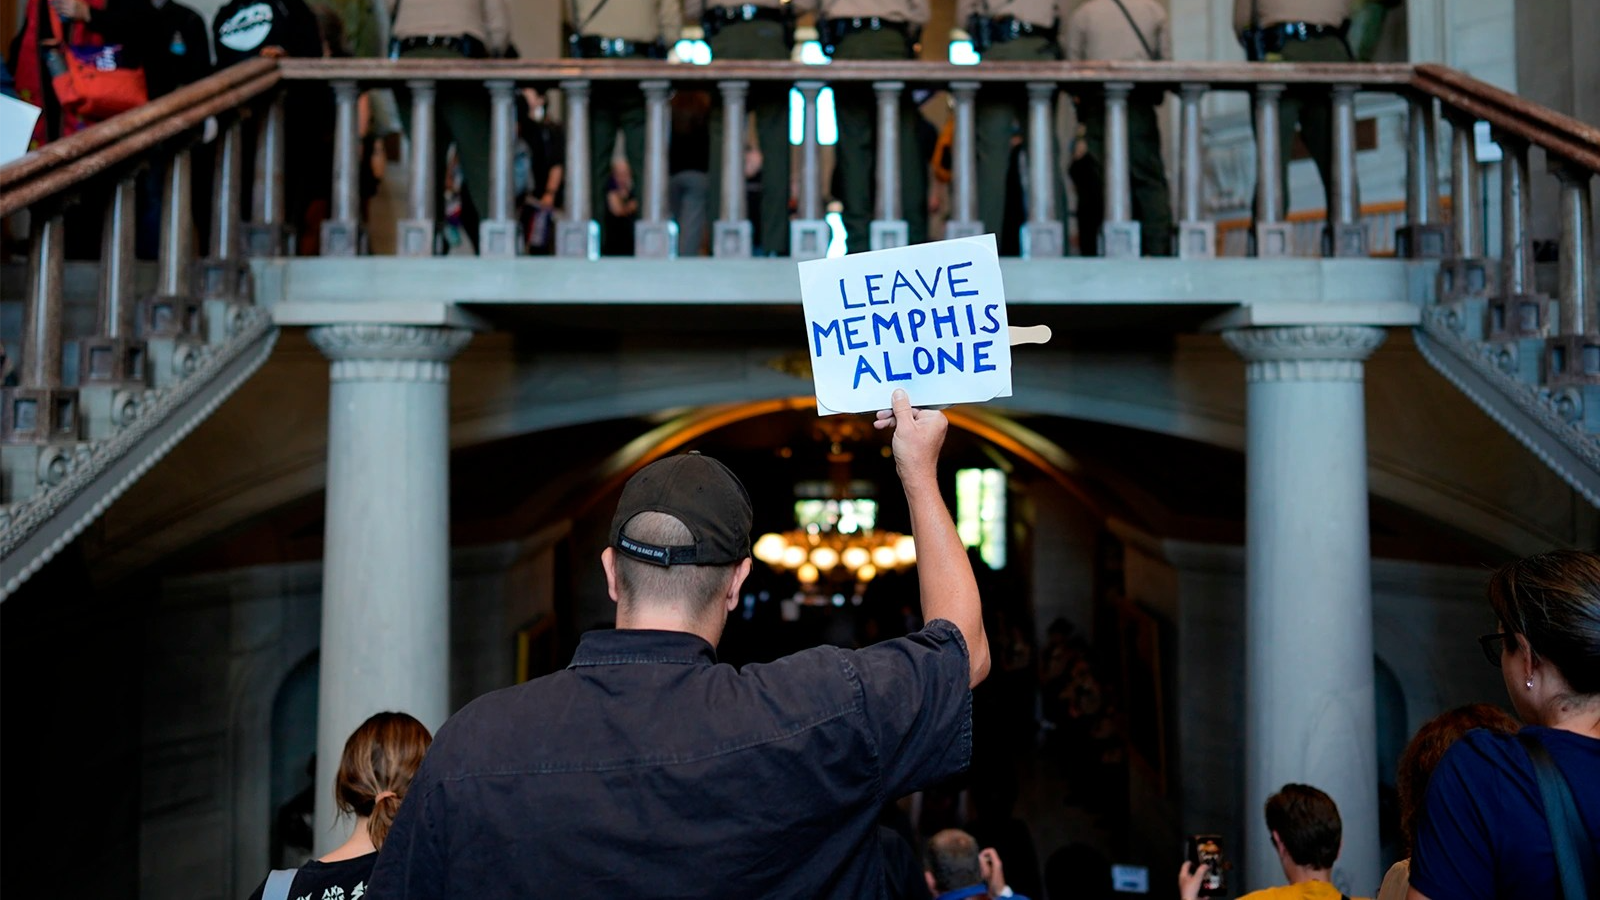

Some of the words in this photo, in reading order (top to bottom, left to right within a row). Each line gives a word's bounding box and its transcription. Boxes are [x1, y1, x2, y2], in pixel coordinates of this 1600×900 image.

[839, 261, 979, 310] LEAVE
[812, 303, 1000, 358] MEMPHIS
[853, 340, 997, 390] ALONE
